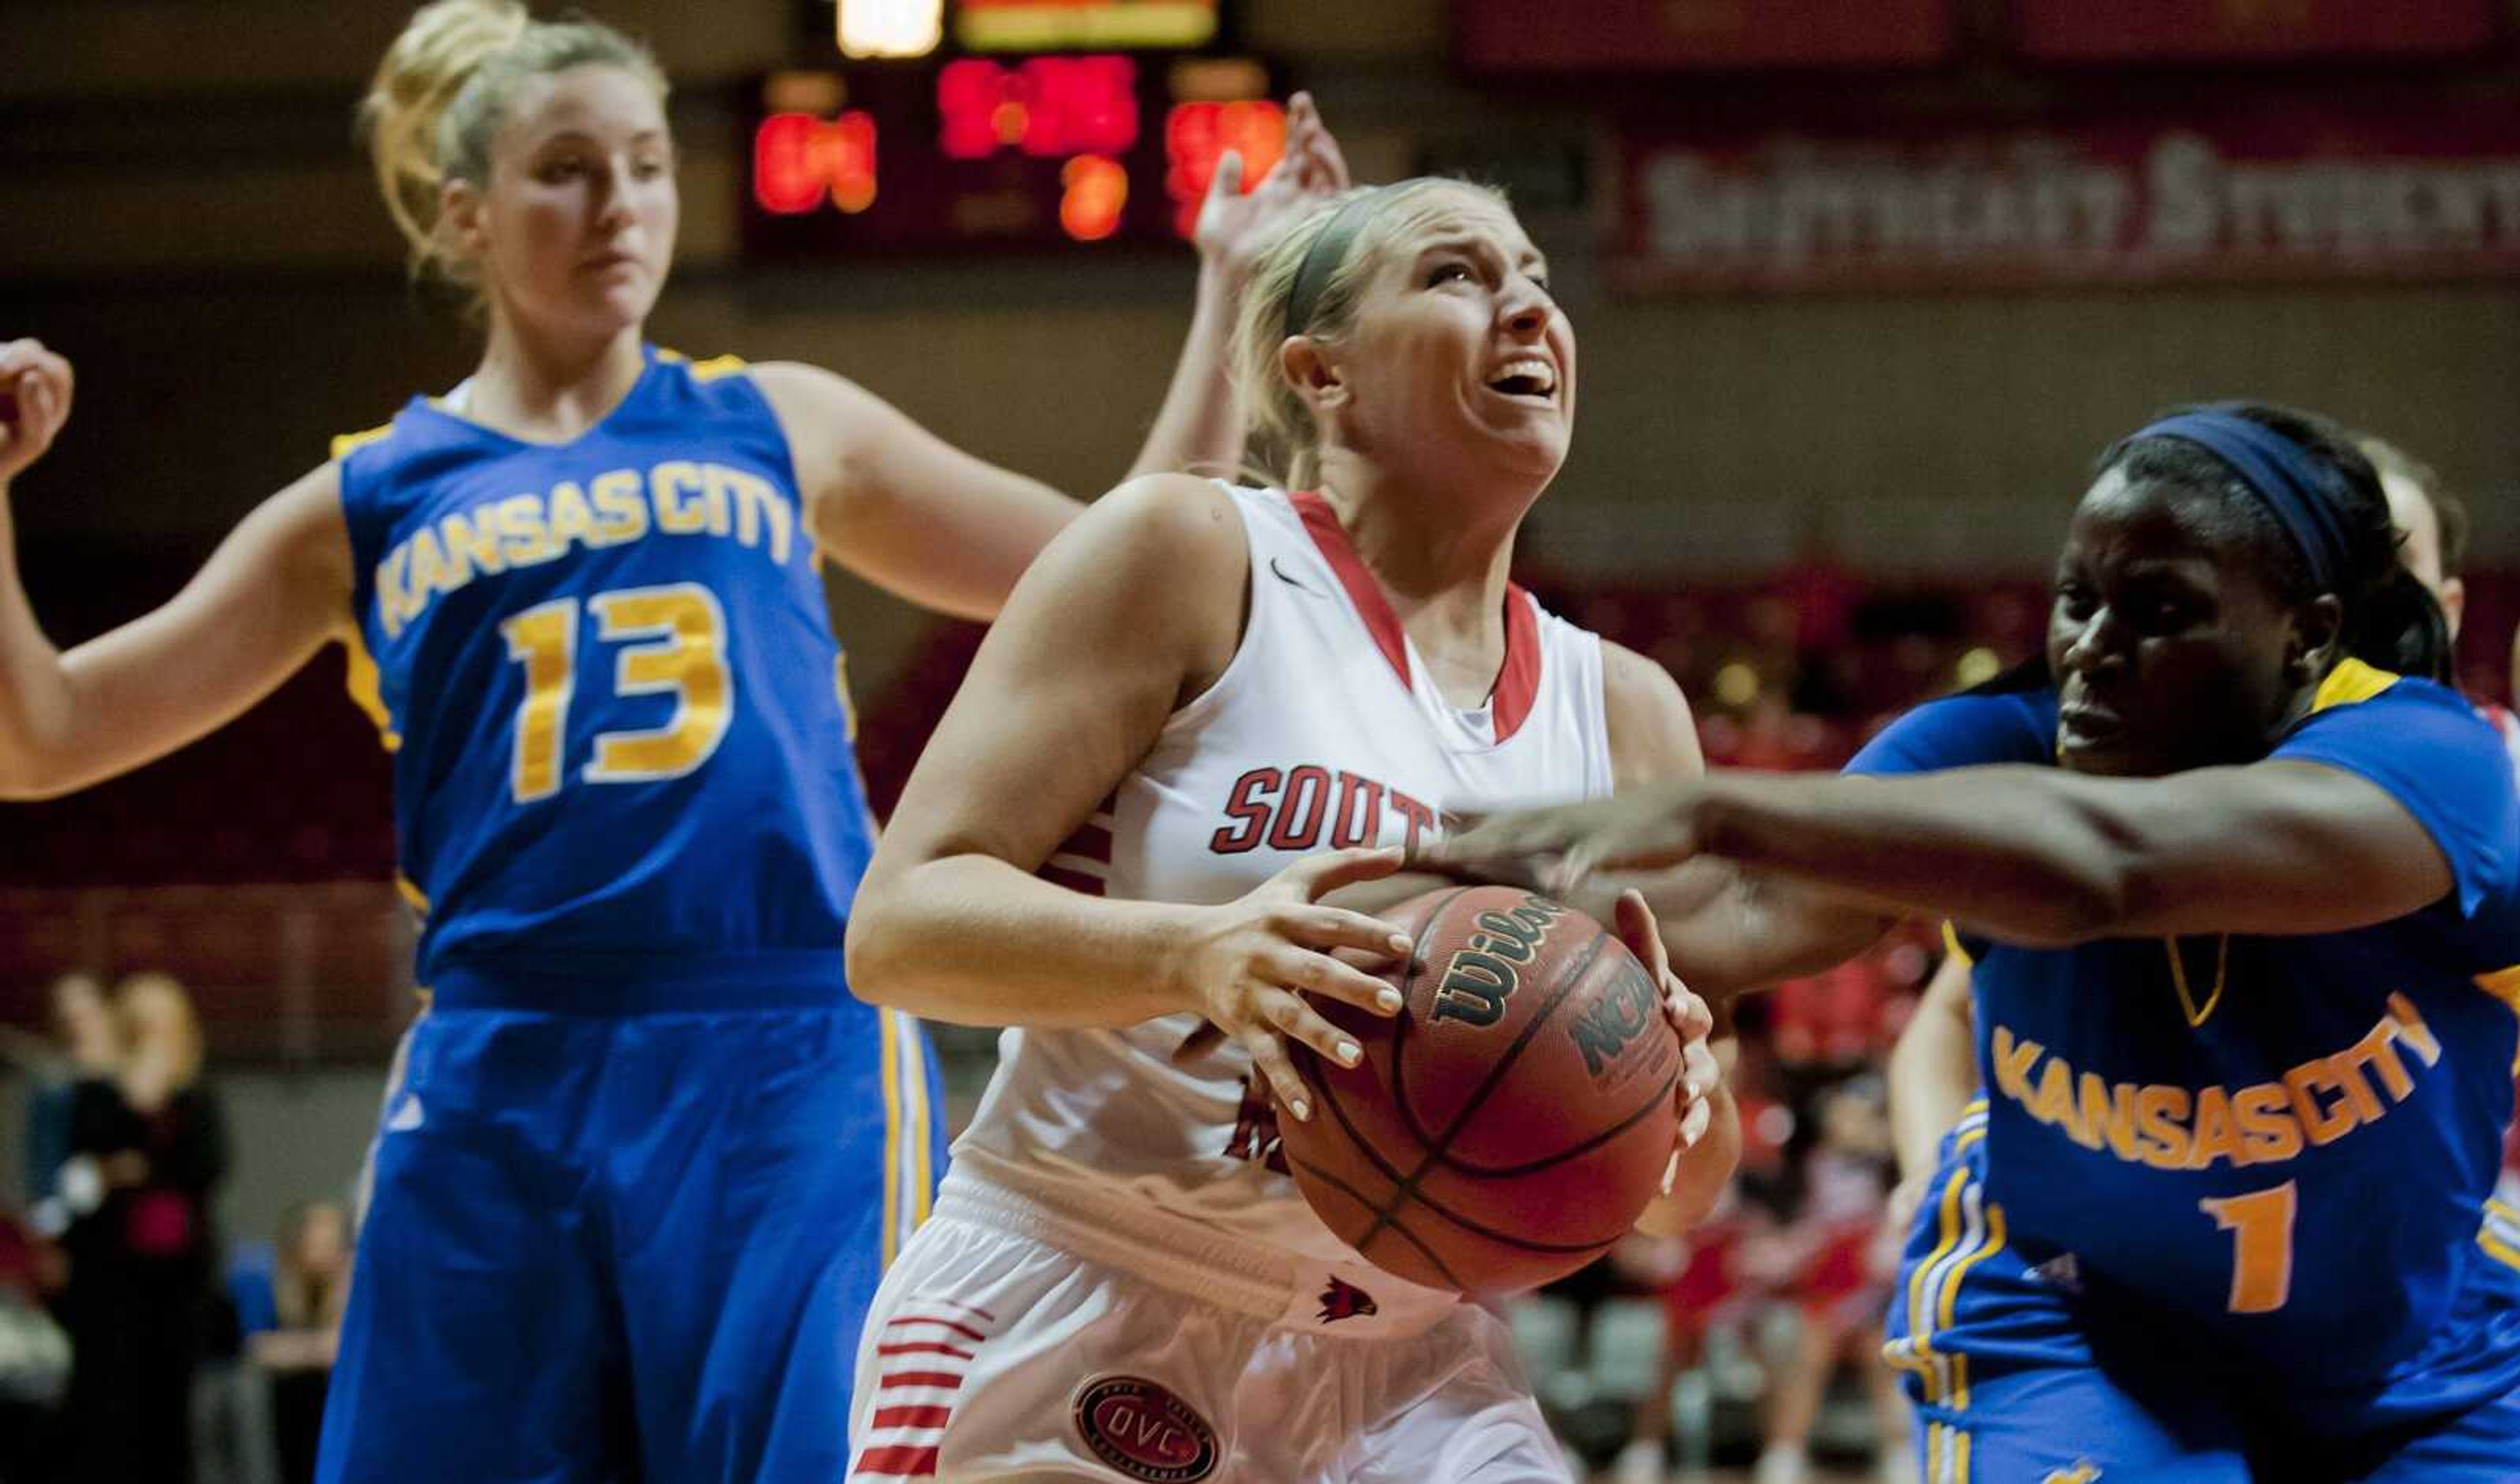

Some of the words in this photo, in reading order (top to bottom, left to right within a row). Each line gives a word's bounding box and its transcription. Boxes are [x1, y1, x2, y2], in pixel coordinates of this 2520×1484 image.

[376, 468, 648, 638] KANSAS
[650, 461, 792, 566] CITY
[499, 582, 734, 803] 13
[1209, 765, 1435, 868] SOUT
[1992, 1026, 2305, 1170] KANSAS
[2284, 990, 2442, 1146] CITY
[2198, 1179, 2298, 1313] 1
[1108, 1405, 1183, 1456] OVC
